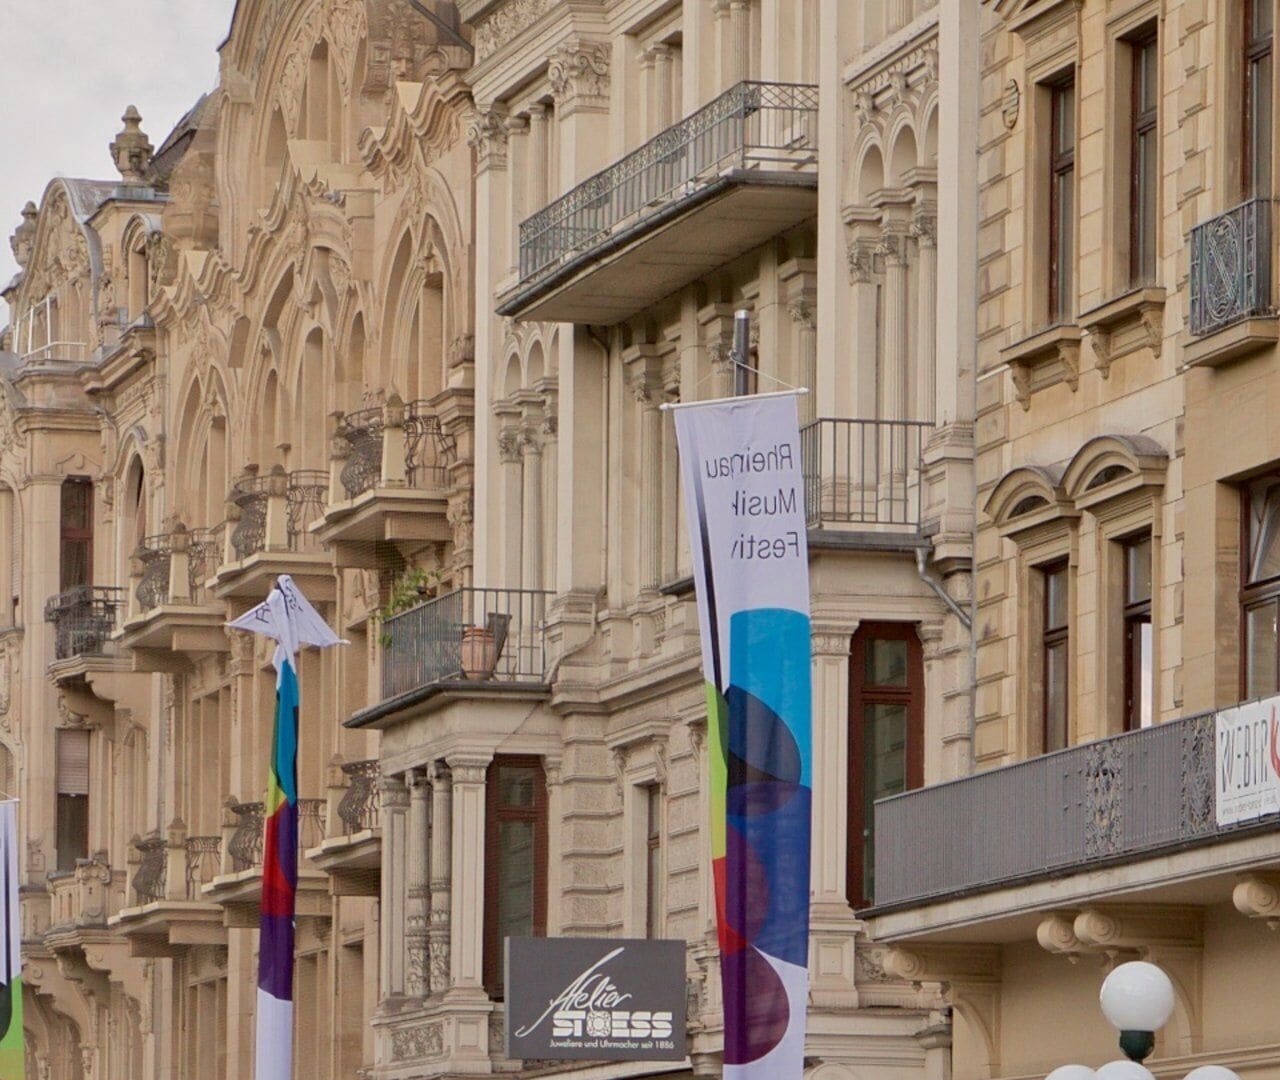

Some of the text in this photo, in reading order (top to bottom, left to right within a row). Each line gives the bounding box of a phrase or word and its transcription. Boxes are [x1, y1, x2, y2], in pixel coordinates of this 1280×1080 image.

[515, 946, 632, 1038] Atelier
[549, 1039, 583, 1048] Juweliere
[584, 1039, 598, 1048] und
[599, 1039, 639, 1049] Uhrmacher
[640, 1041, 653, 1049] seit
